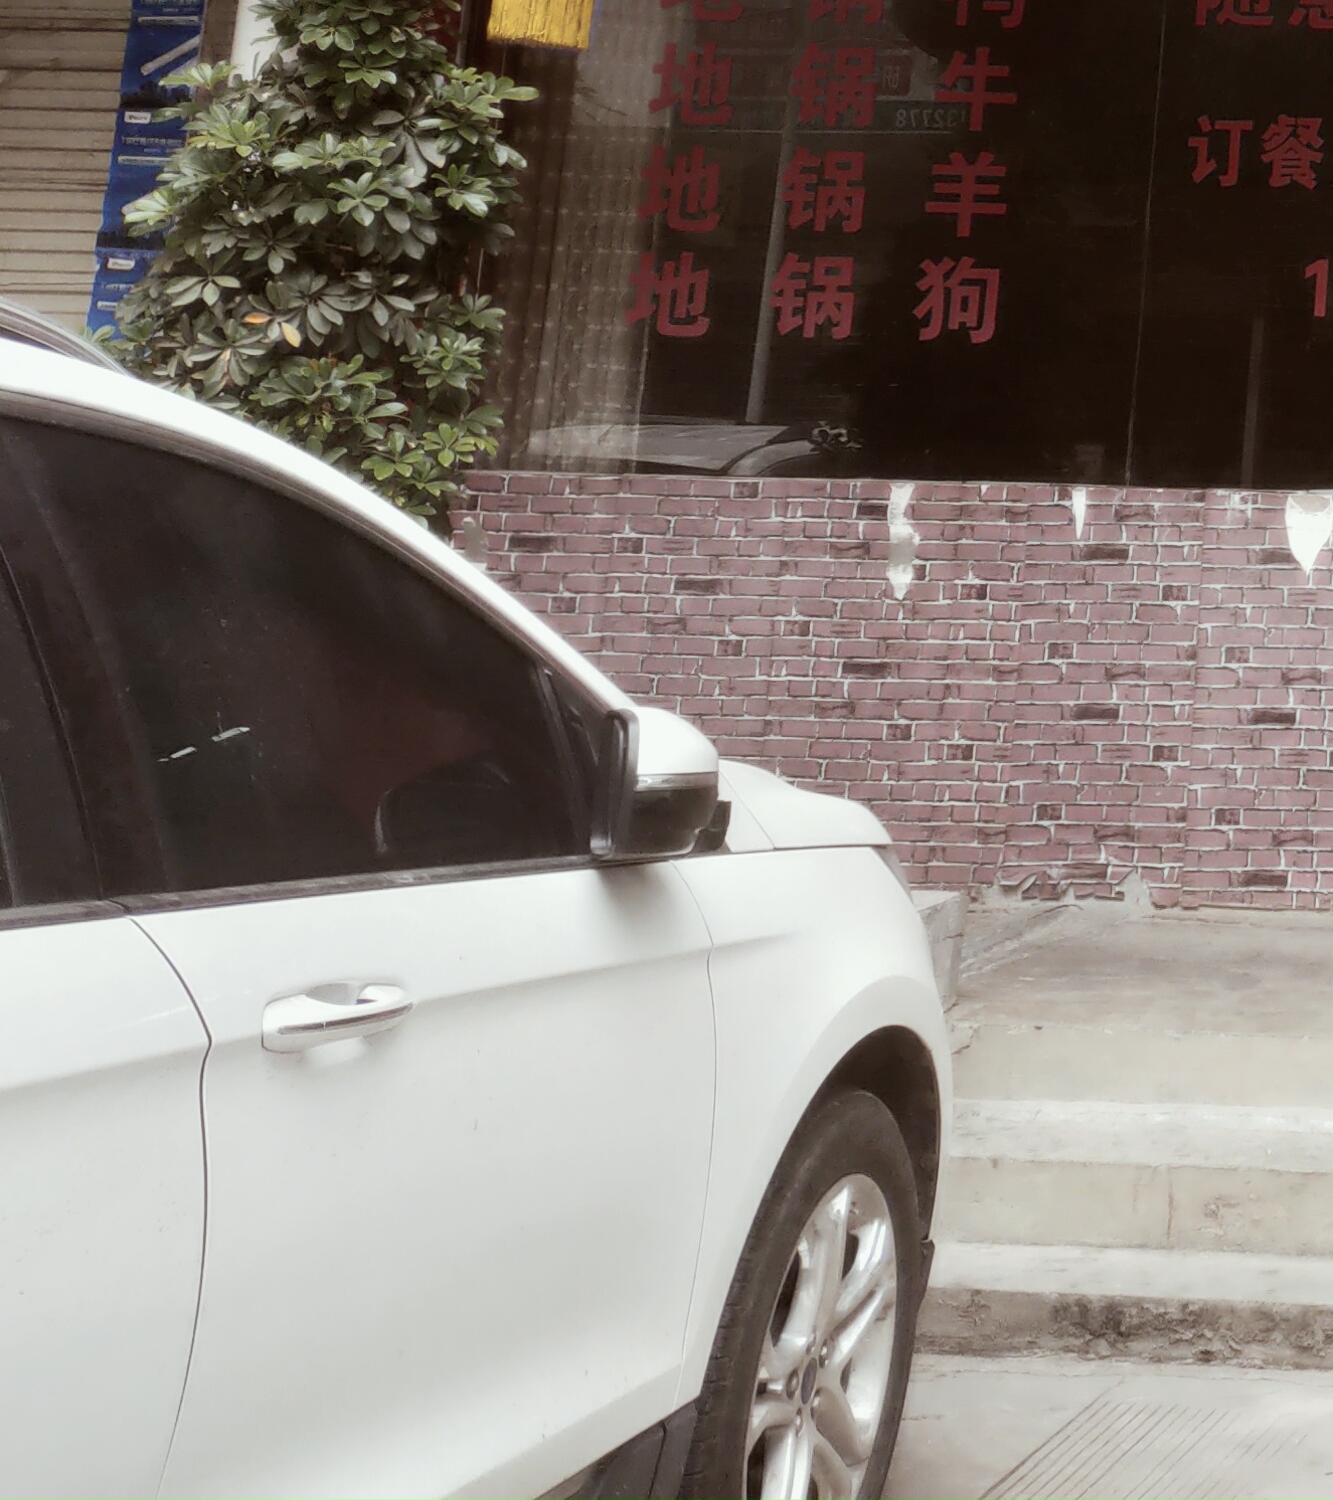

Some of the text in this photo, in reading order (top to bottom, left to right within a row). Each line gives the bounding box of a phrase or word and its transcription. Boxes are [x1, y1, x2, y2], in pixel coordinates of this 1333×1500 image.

[649, 42, 1018, 132] 地锅牛
[635, 145, 1007, 238] 地锅羊
[624, 251, 1000, 344] 地锅狗
